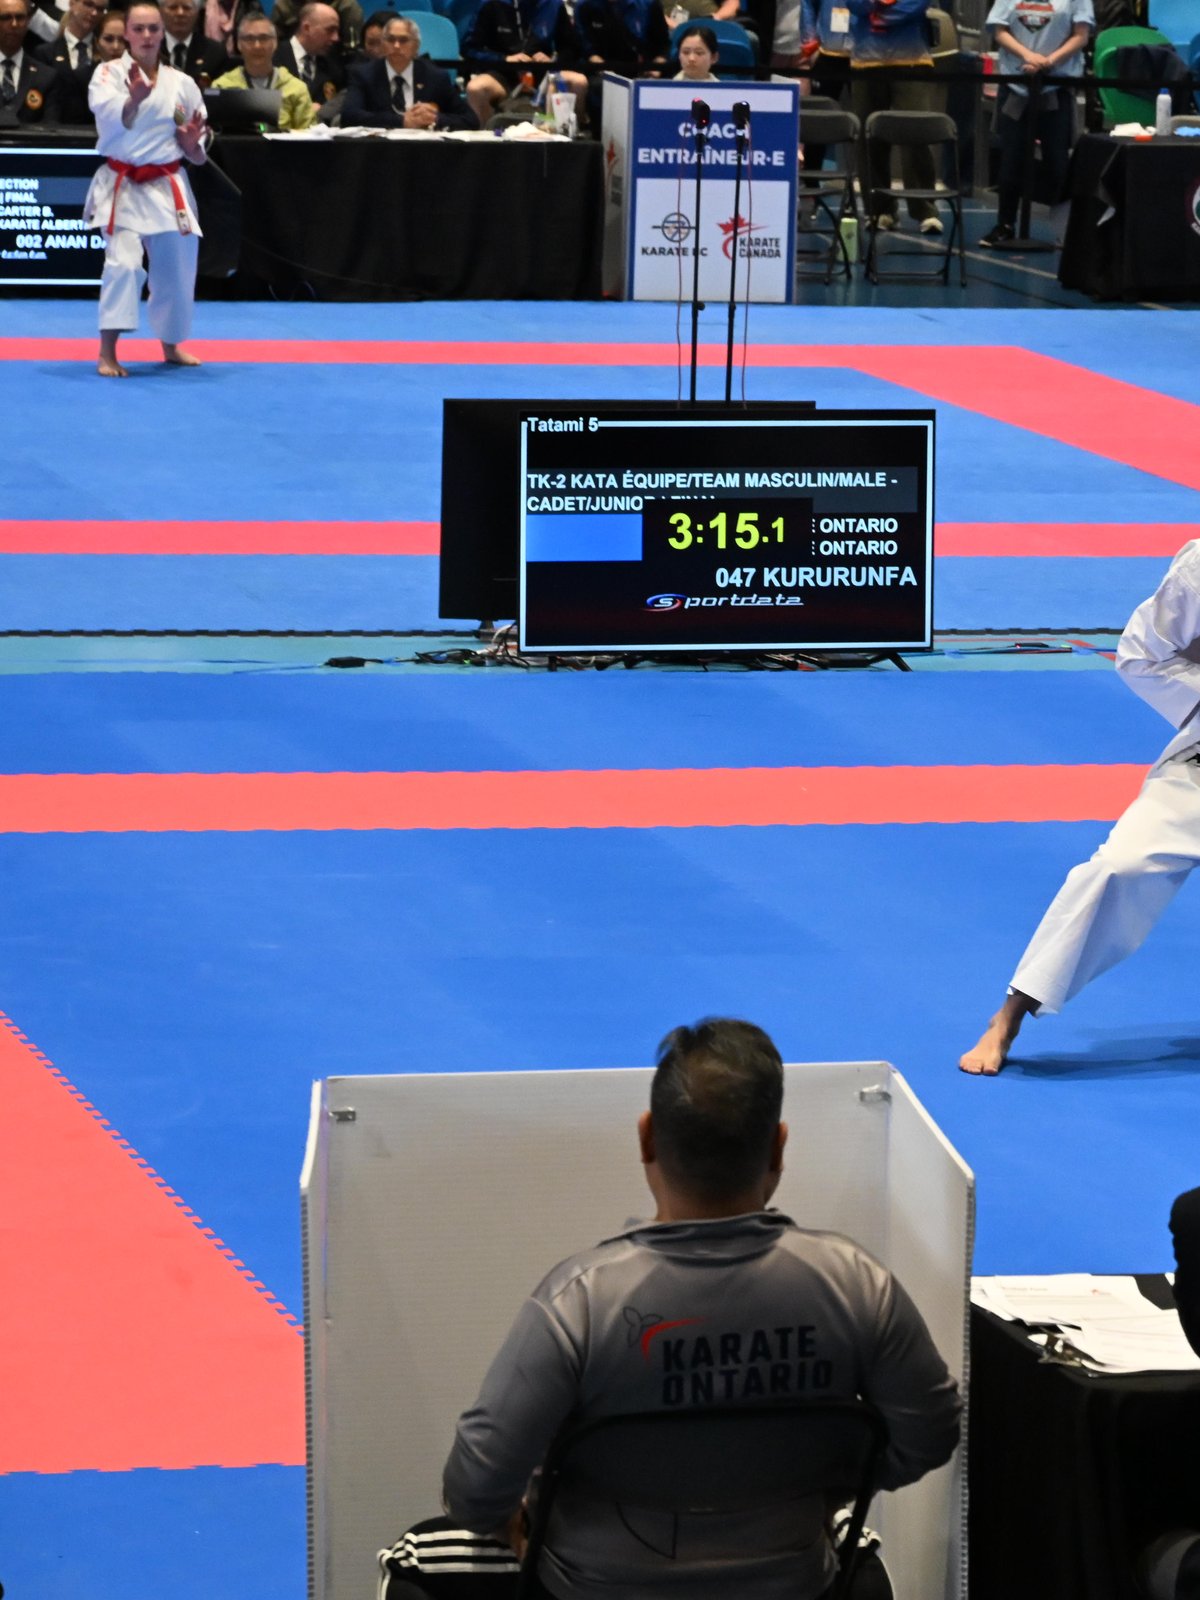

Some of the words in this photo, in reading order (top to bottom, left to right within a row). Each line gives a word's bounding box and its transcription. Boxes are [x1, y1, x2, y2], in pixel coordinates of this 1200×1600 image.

[5, 192, 37, 203] FINAL
[16, 234, 42, 249] 002
[45, 234, 88, 249] ANAN
[739, 237, 781, 248] KARATE
[641, 247, 689, 257] KARATE
[739, 248, 781, 259] CANADA
[527, 417, 583, 432] Tatami
[588, 417, 599, 432] 5
[527, 473, 566, 489] TK-2
[571, 473, 618, 489] KATA
[622, 469, 740, 490] ÉQUIPE/TEAM
[744, 472, 887, 488] MASCULIN/MALE
[527, 496, 655, 512] CADET/JUNIO
[667, 512, 784, 550] 3:15.1
[819, 517, 898, 533] ONTARIO
[819, 539, 898, 555] ONTARIO
[715, 567, 756, 588] 047
[764, 566, 918, 588] KURURUNFA
[662, 1325, 816, 1373] KARATE
[662, 1360, 833, 1406] ONTARIO
